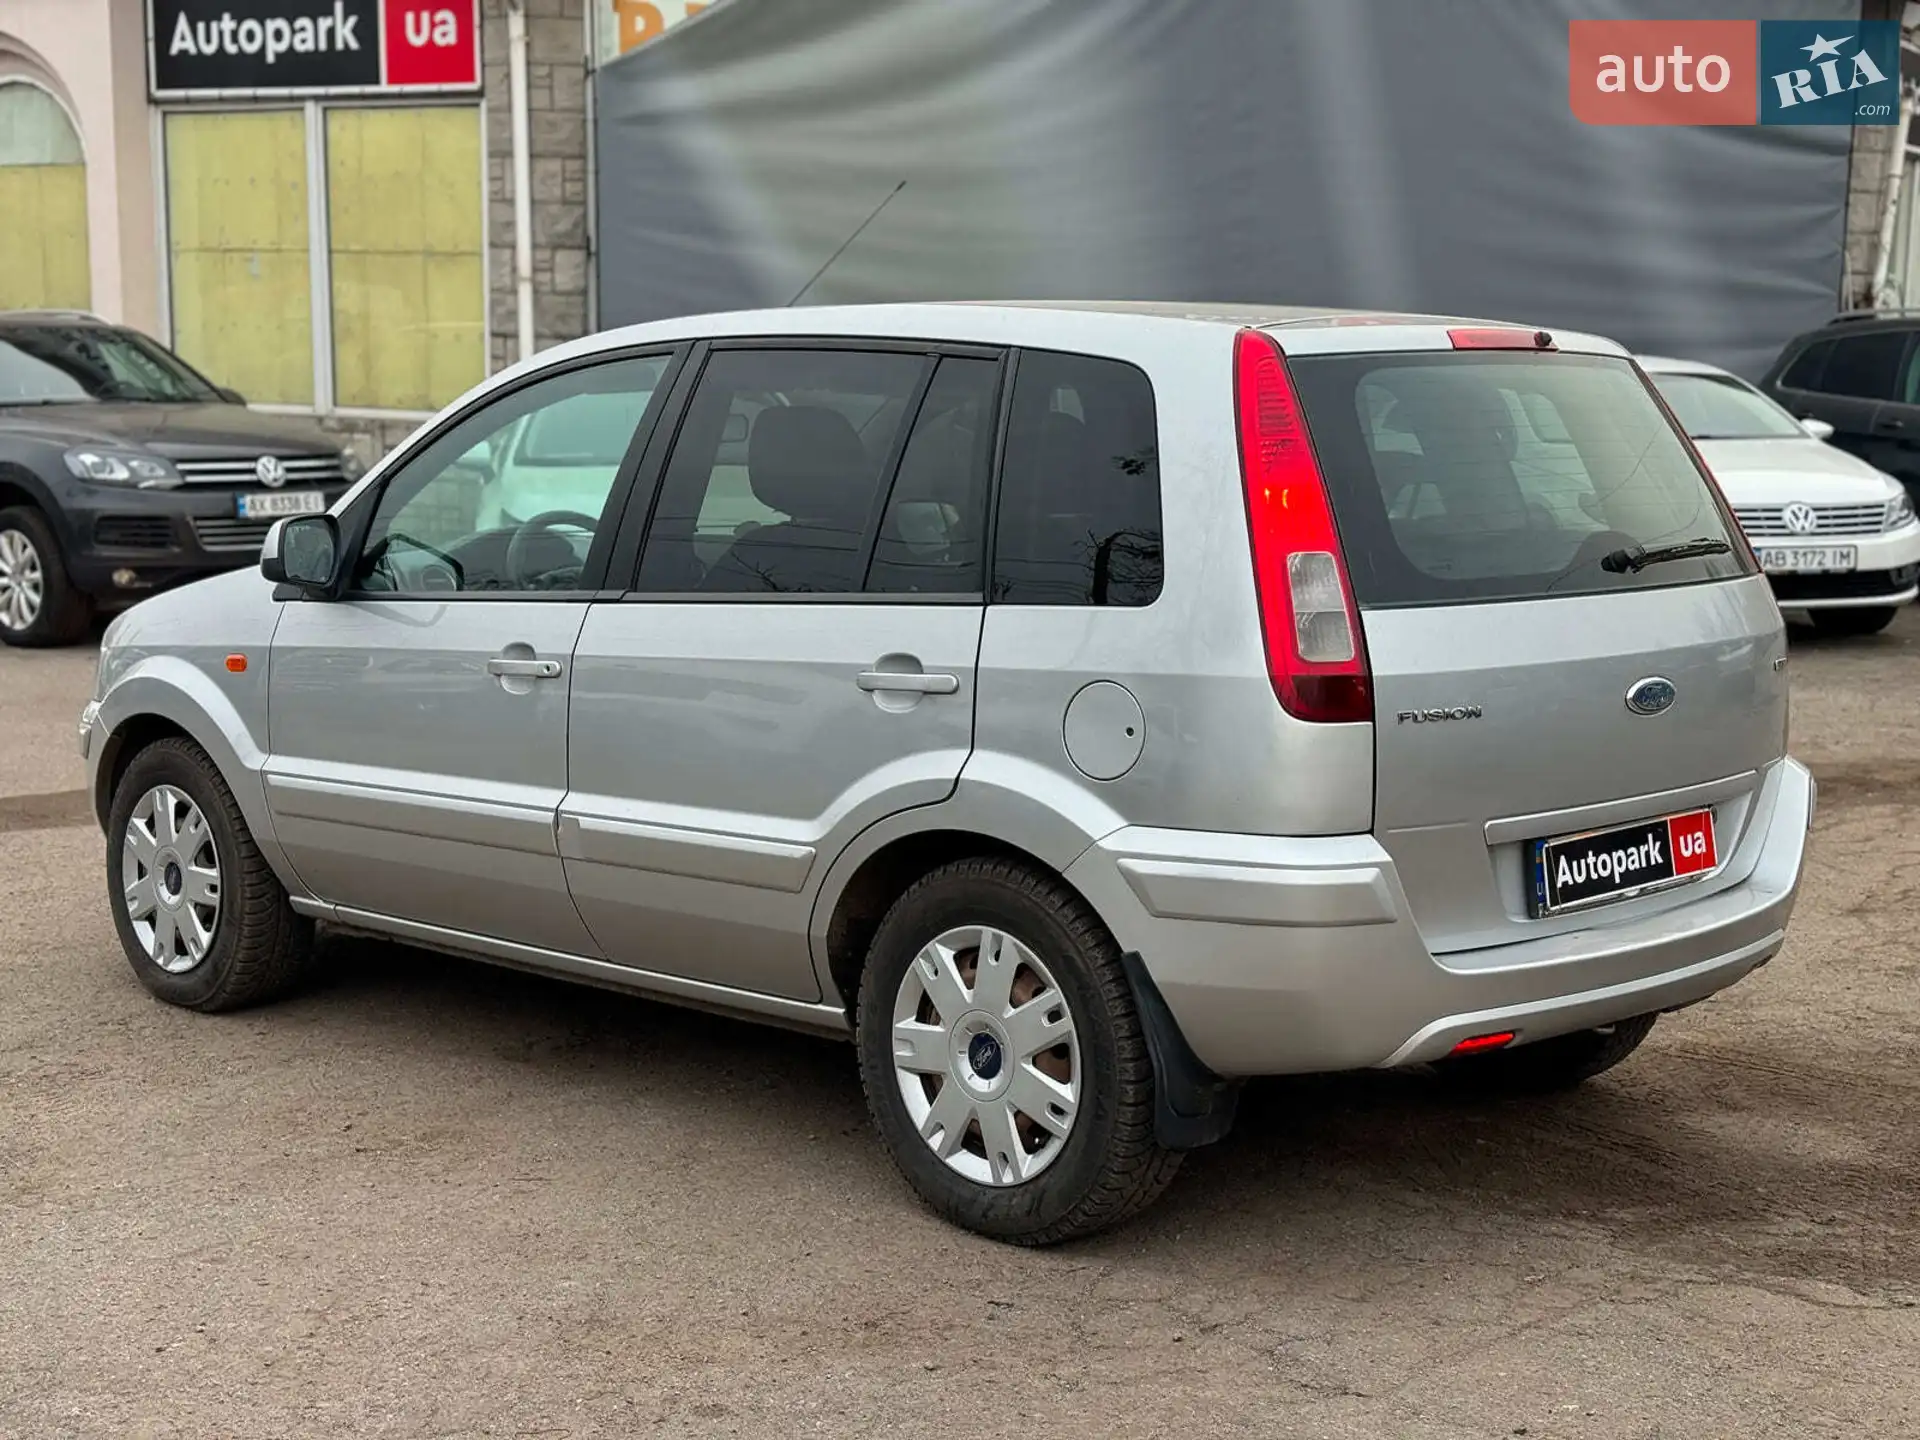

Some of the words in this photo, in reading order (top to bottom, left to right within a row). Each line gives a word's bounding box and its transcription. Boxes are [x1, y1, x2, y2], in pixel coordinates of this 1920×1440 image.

[169, 0, 361, 64] Autopark
[404, 9, 459, 47] ua
[1763, 551, 1788, 567] AB
[1790, 550, 1827, 567] 3172
[1397, 704, 1483, 726] FUSION
[1556, 832, 1664, 889] Autopark
[1679, 831, 1706, 857] ua
